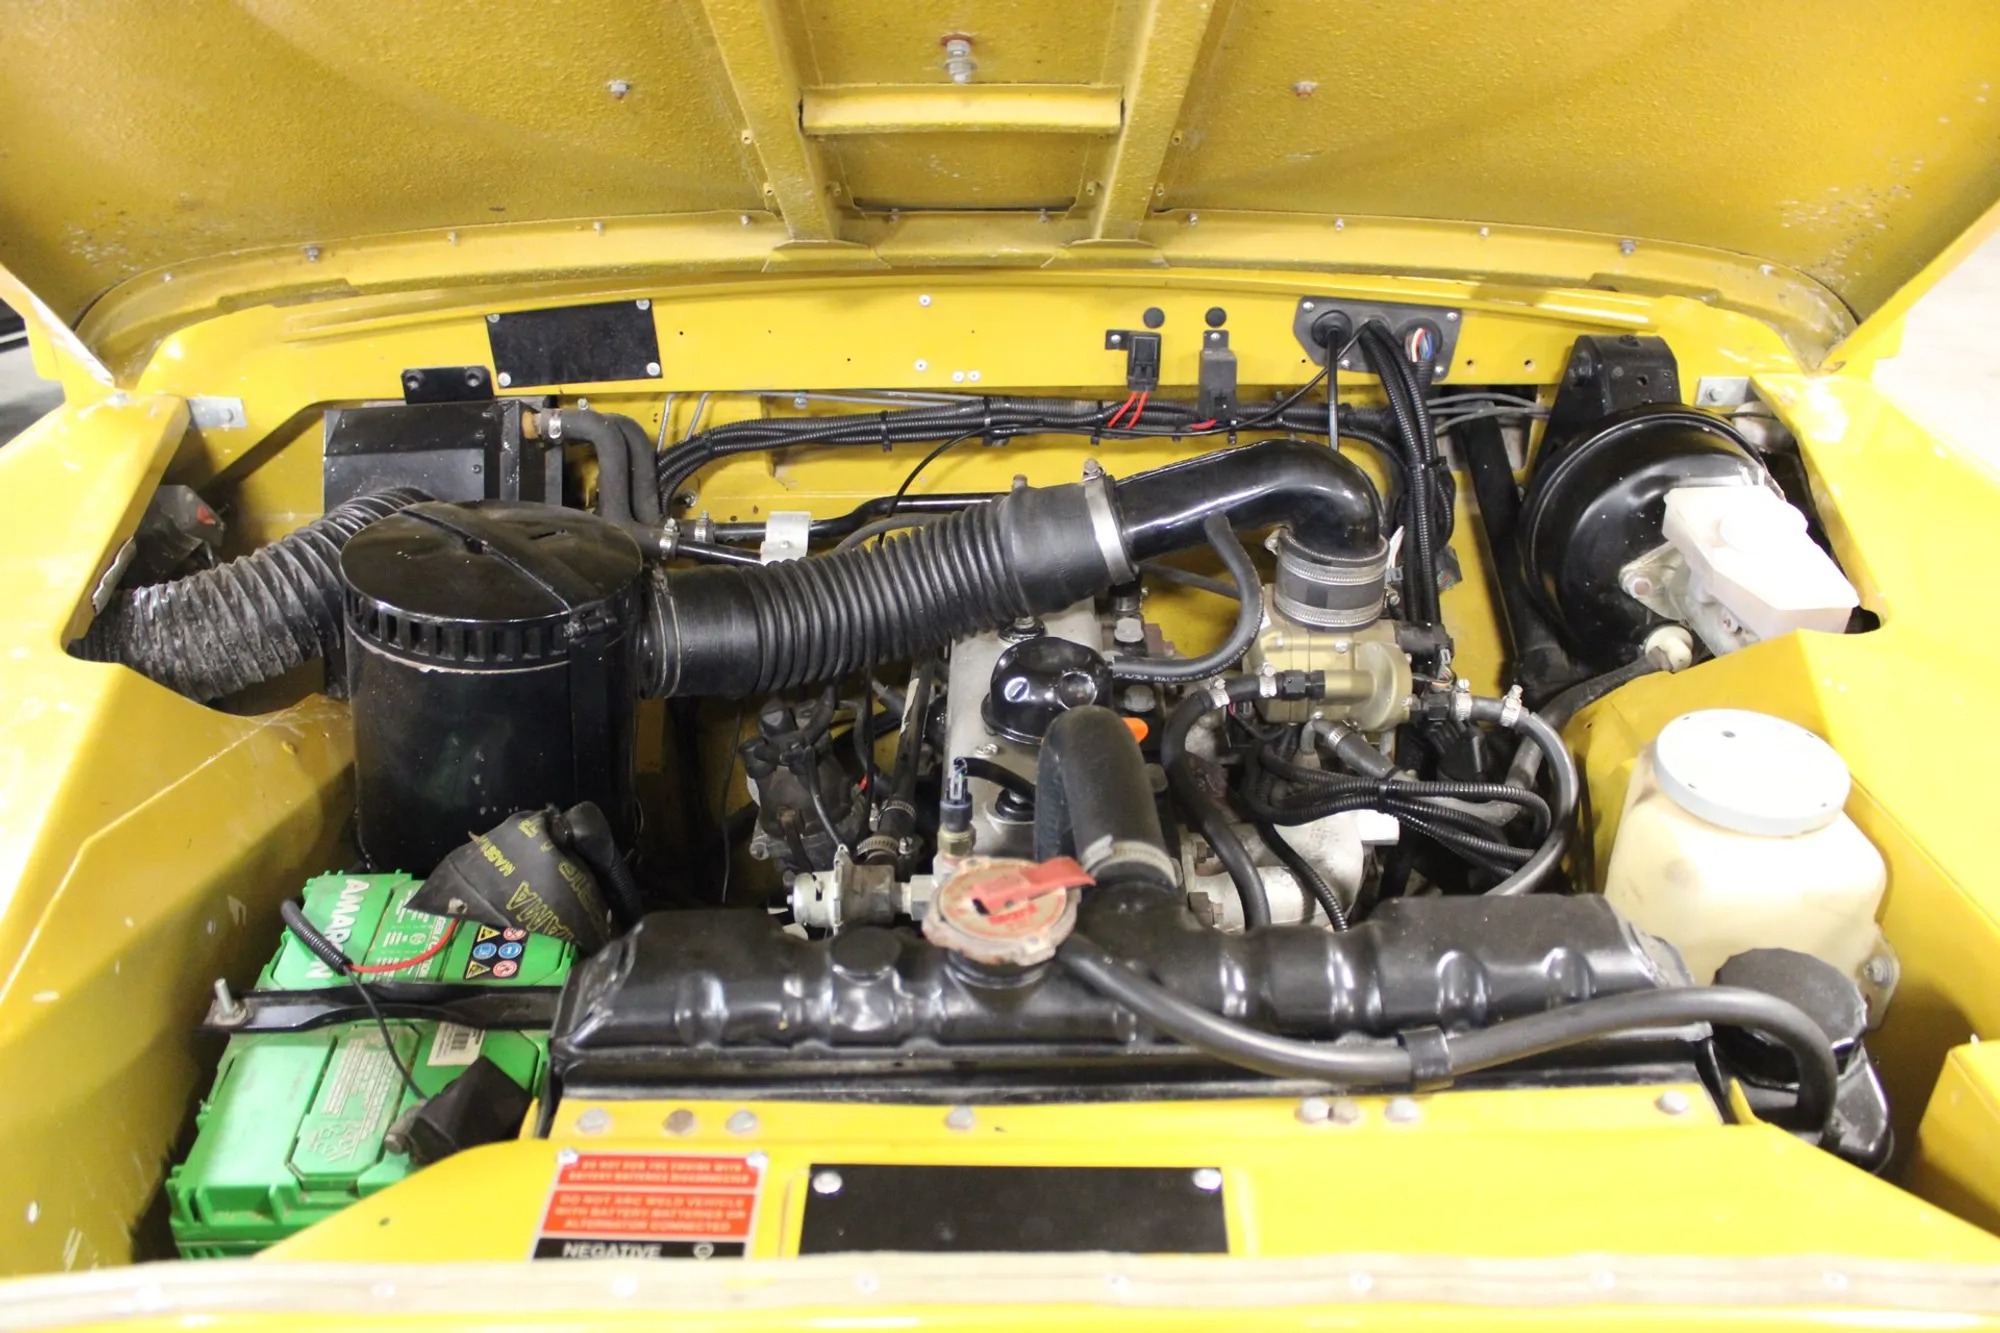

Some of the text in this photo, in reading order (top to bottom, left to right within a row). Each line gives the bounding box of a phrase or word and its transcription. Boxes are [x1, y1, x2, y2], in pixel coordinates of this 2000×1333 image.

[305, 878, 370, 979] AMARN
[599, 1160, 621, 1170] NOT
[559, 1194, 744, 1208] DO NOT ARC WELD VEHICLE
[555, 1206, 588, 1216] WITH
[590, 1207, 649, 1218] BATTERY
[563, 1219, 731, 1232] ALTERNATOR CONNECTED
[561, 1241, 662, 1259] NEGATIVE
